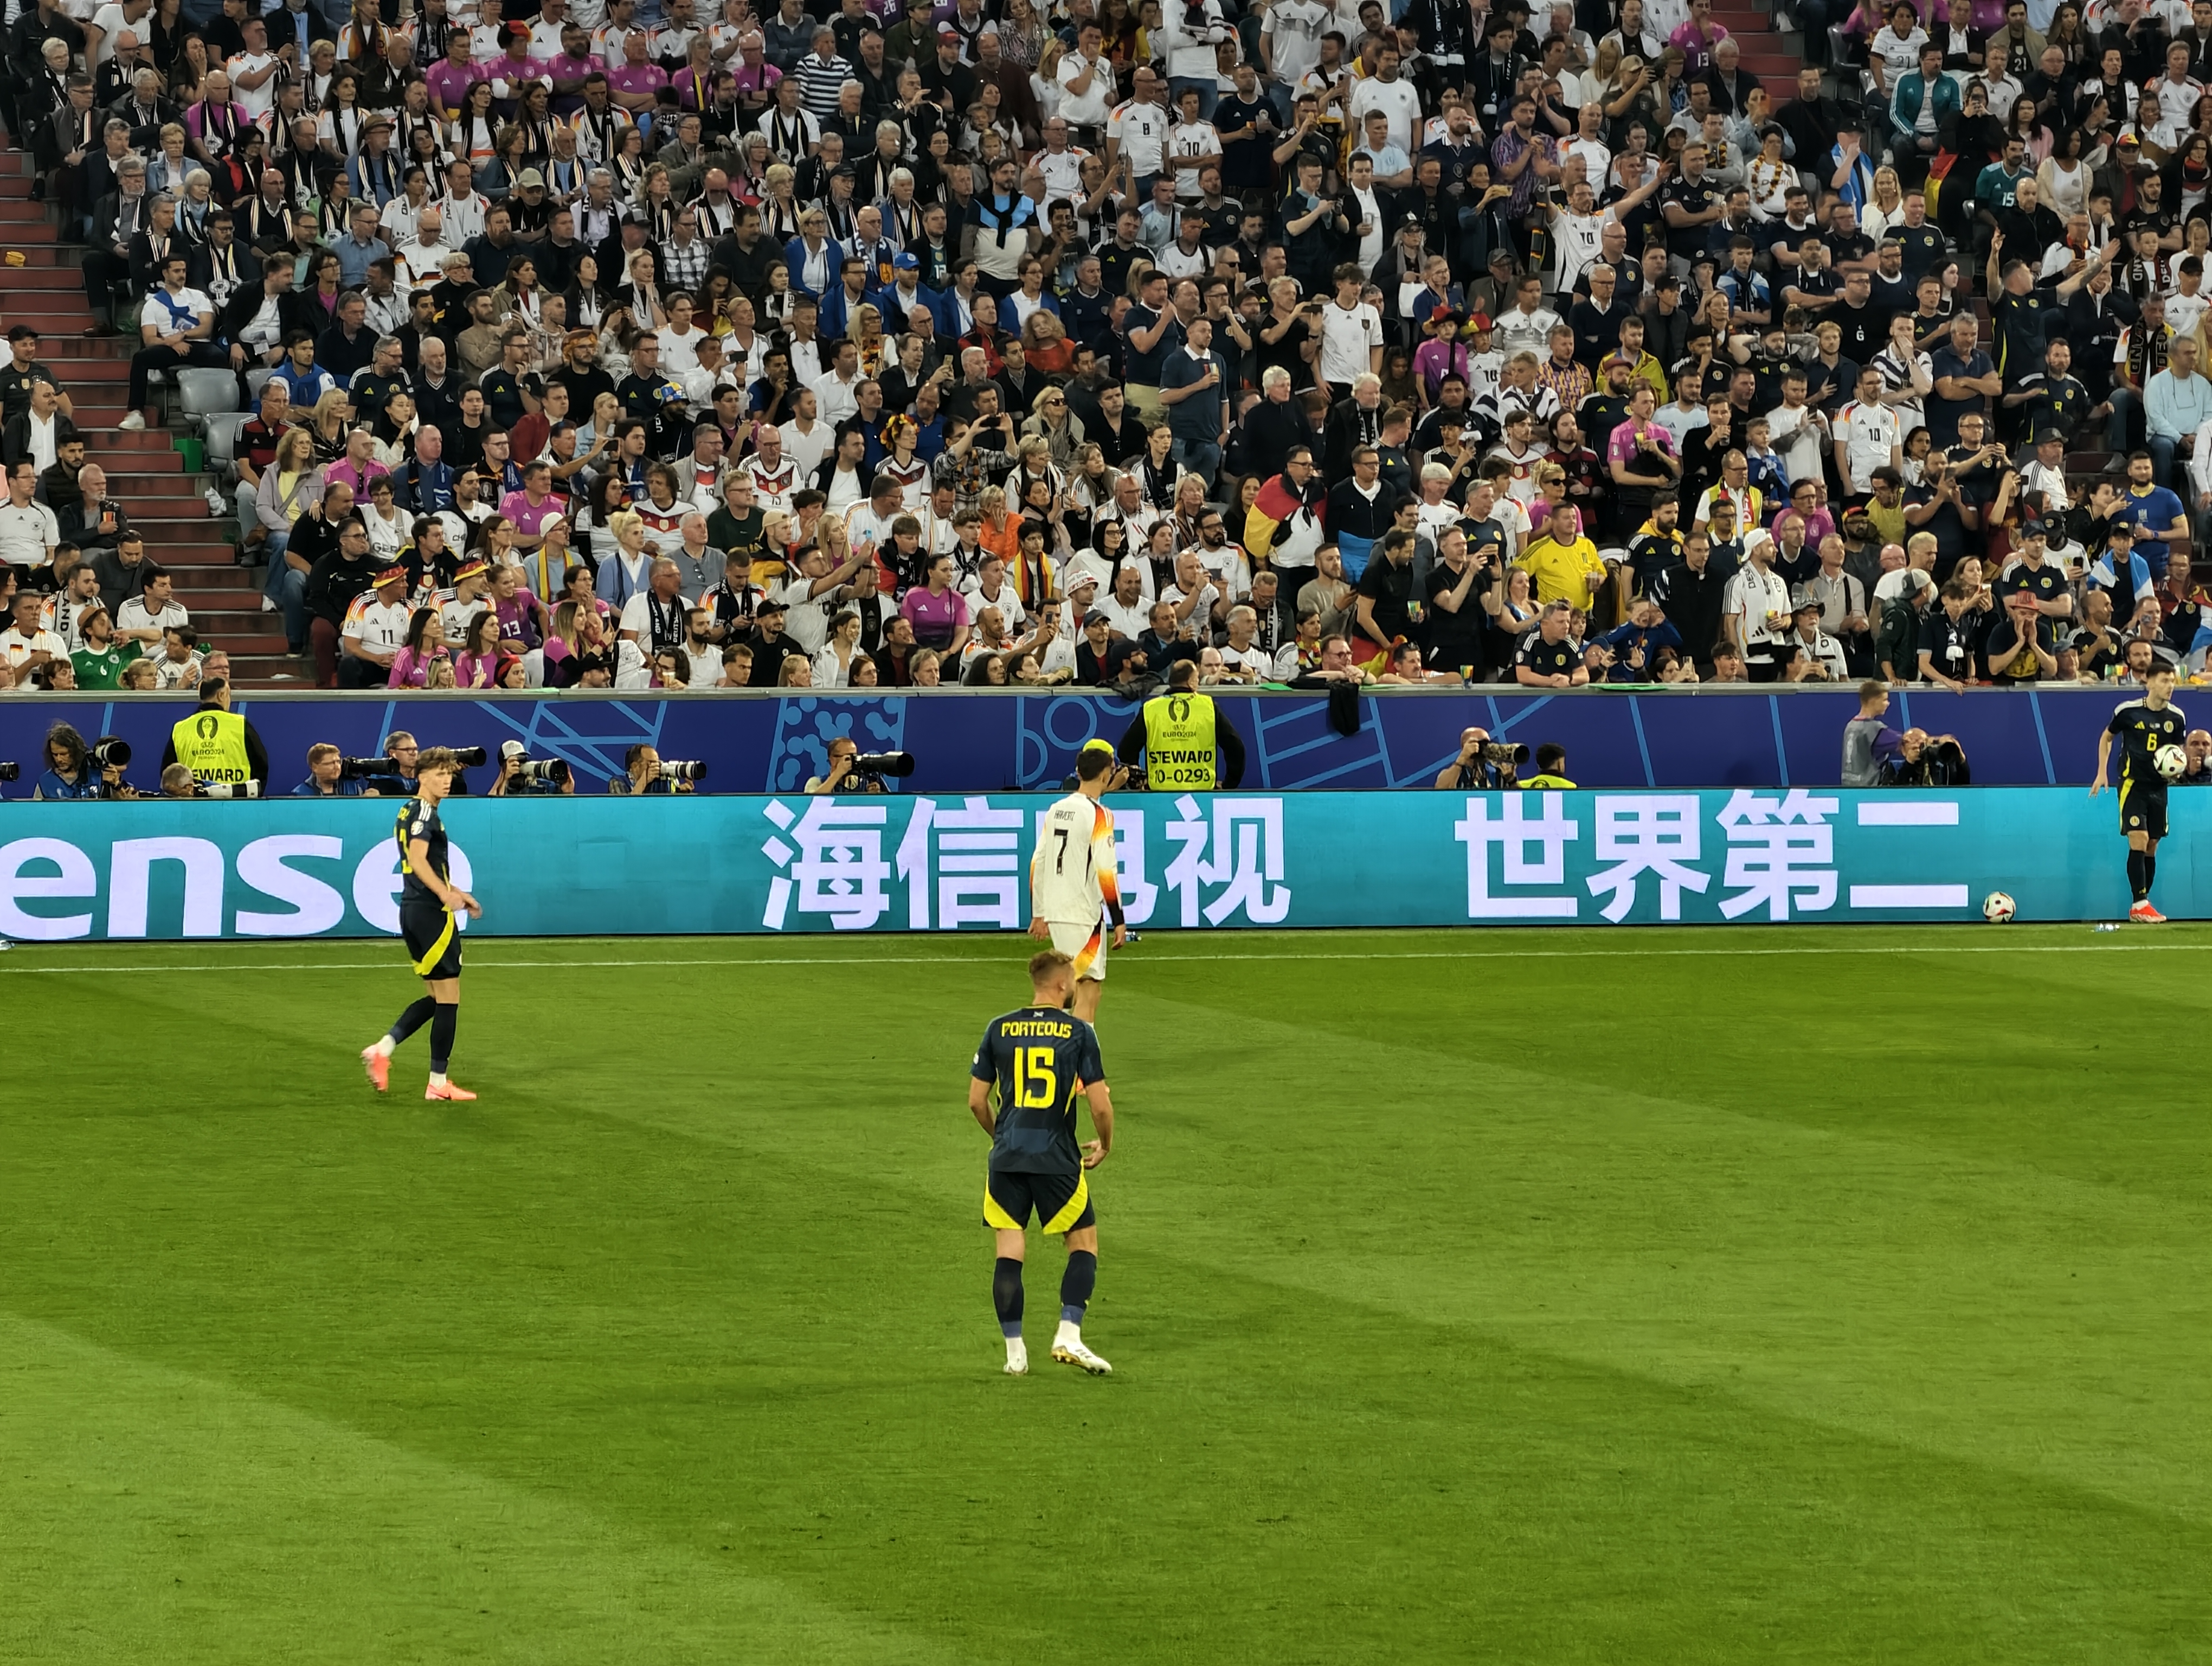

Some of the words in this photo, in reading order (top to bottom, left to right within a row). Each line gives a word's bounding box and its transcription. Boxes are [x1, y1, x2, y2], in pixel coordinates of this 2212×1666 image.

[1697, 53, 1709, 67] 13
[2014, 58, 2027, 72] 21
[1142, 123, 1150, 135] 8
[2002, 192, 2015, 207] 15
[1579, 232, 1594, 245] 10
[1483, 370, 1497, 383] 10
[1869, 428, 1881, 441] 10
[503, 620, 522, 637] 13
[381, 630, 394, 644] 11
[2146, 733, 2157, 752] 6
[1149, 750, 1212, 764] STEWARD
[192, 768, 245, 782] EWARD
[1154, 768, 1211, 784] 10-0293
[1054, 828, 1069, 876] 7
[1454, 789, 1969, 924] 世界第二
[1001, 1021, 1073, 1039] PORTEOUS
[1013, 1047, 1056, 1109] 15
